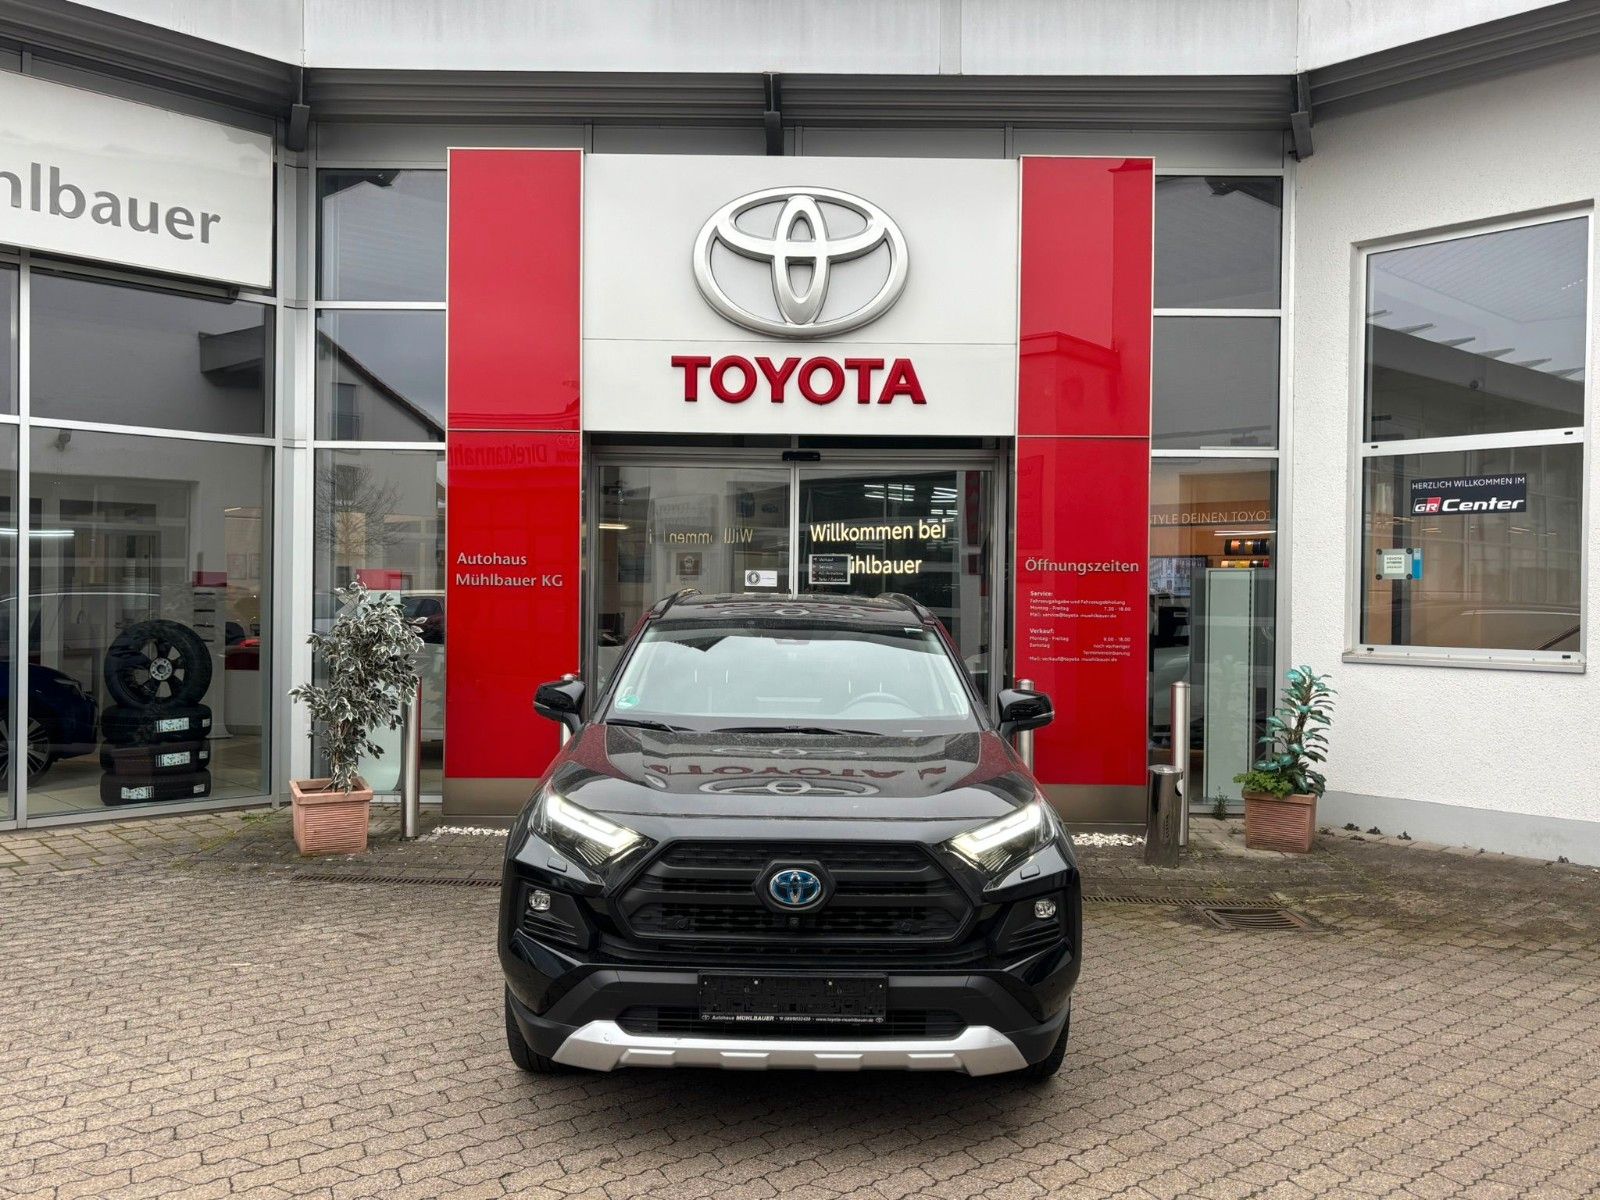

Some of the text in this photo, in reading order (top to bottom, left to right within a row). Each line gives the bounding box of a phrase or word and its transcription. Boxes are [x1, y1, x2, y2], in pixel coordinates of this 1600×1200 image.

[671, 355, 927, 405] TOYOTA
[1412, 481, 1452, 490] HERZLICH
[1454, 478, 1512, 488] WILLKOMMEN
[1442, 497, 1524, 512] Center
[1181, 512, 1228, 523] DEINEN
[810, 519, 946, 542] Willkommen bei
[457, 552, 527, 565] Autohaus
[1025, 557, 1139, 575] Öffnungszeiten
[456, 573, 563, 587] Mühlbauer KG
